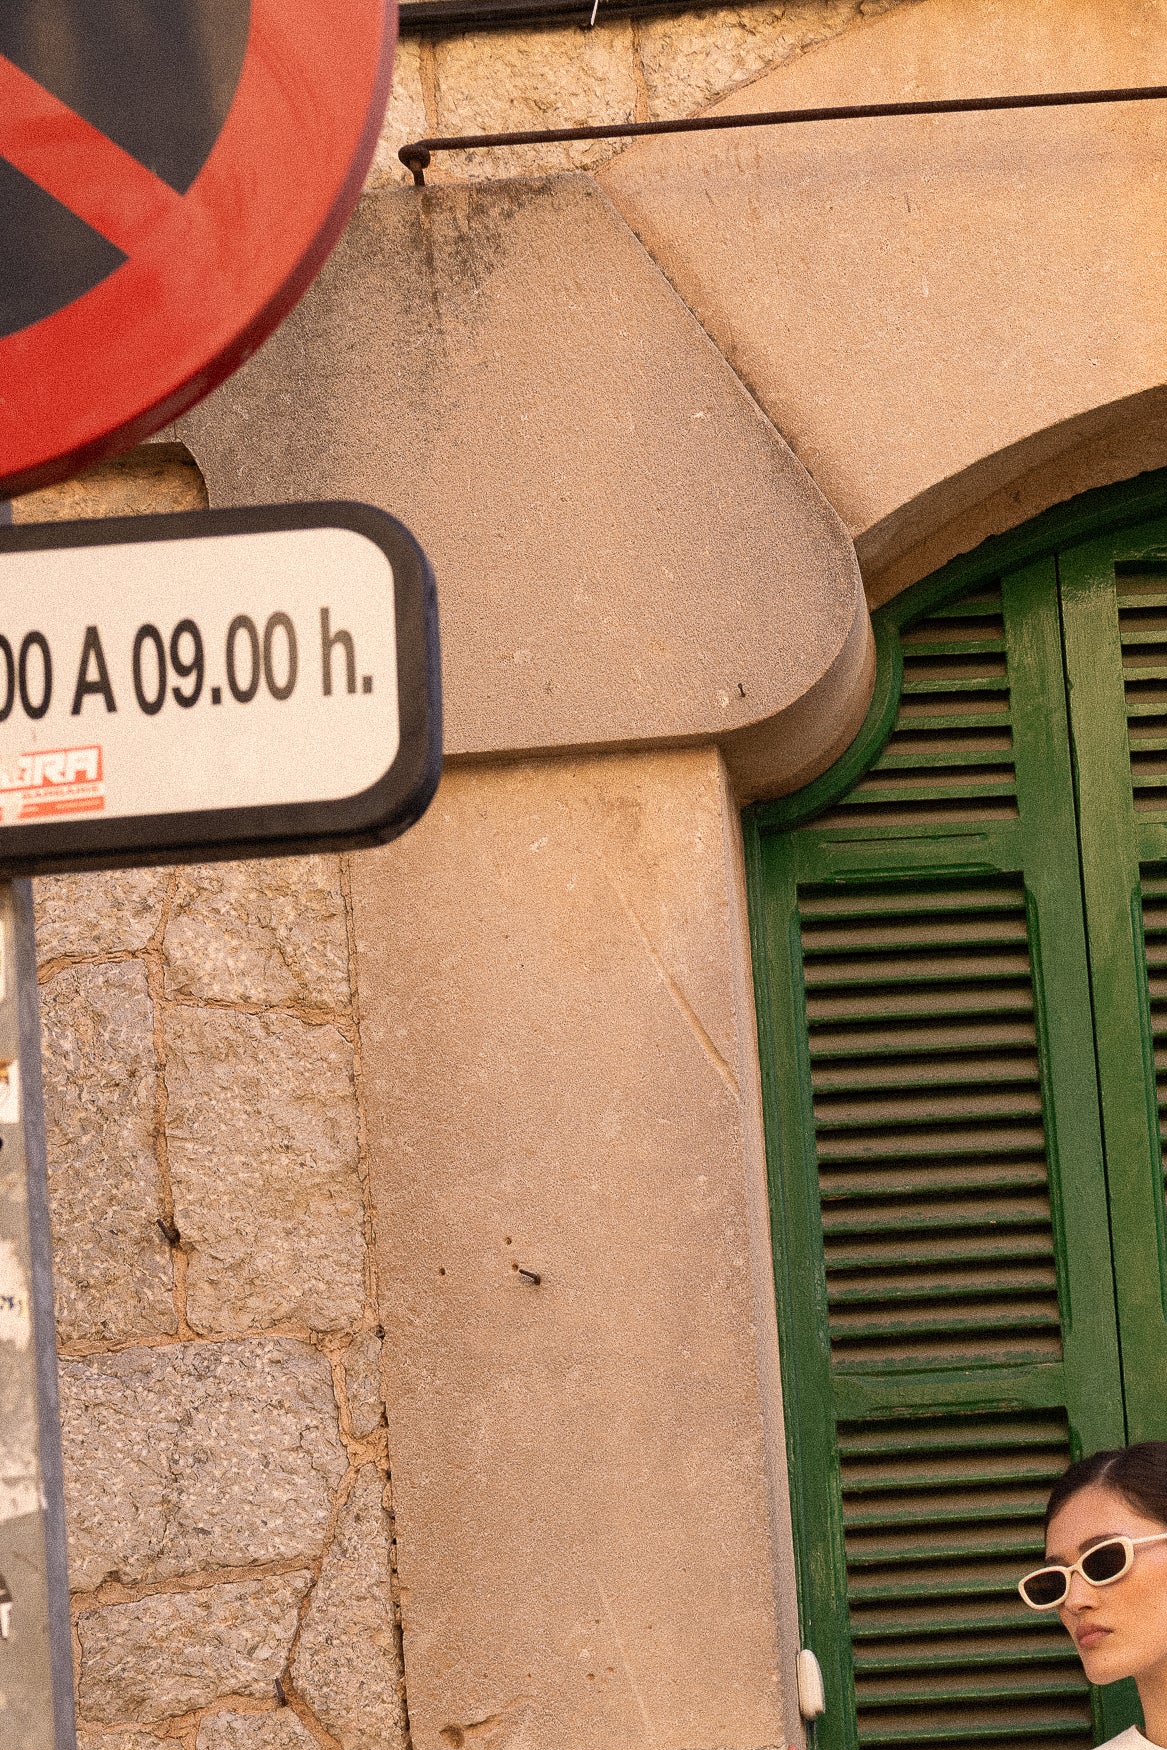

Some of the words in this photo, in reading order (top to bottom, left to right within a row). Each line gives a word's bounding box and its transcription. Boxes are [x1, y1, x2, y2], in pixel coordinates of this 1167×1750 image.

[71, 626, 117, 715] A
[132, 612, 298, 716] 09.00
[320, 607, 373, 696] h.
